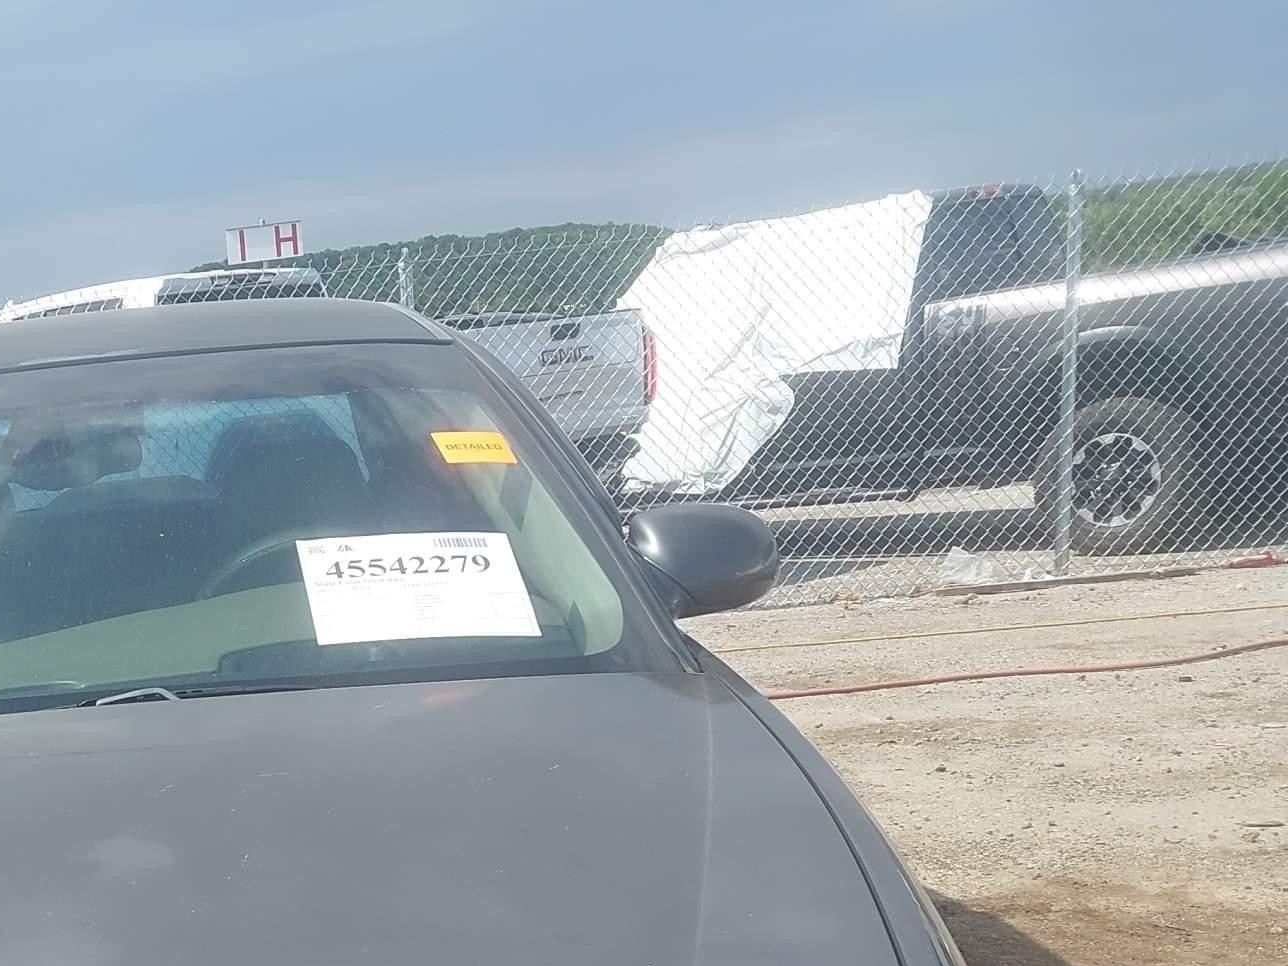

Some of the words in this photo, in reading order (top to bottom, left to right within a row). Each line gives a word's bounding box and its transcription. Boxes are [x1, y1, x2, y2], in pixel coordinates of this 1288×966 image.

[274, 223, 299, 257] H
[445, 442, 503, 451] DETAILED
[325, 554, 491, 579] 45542279
